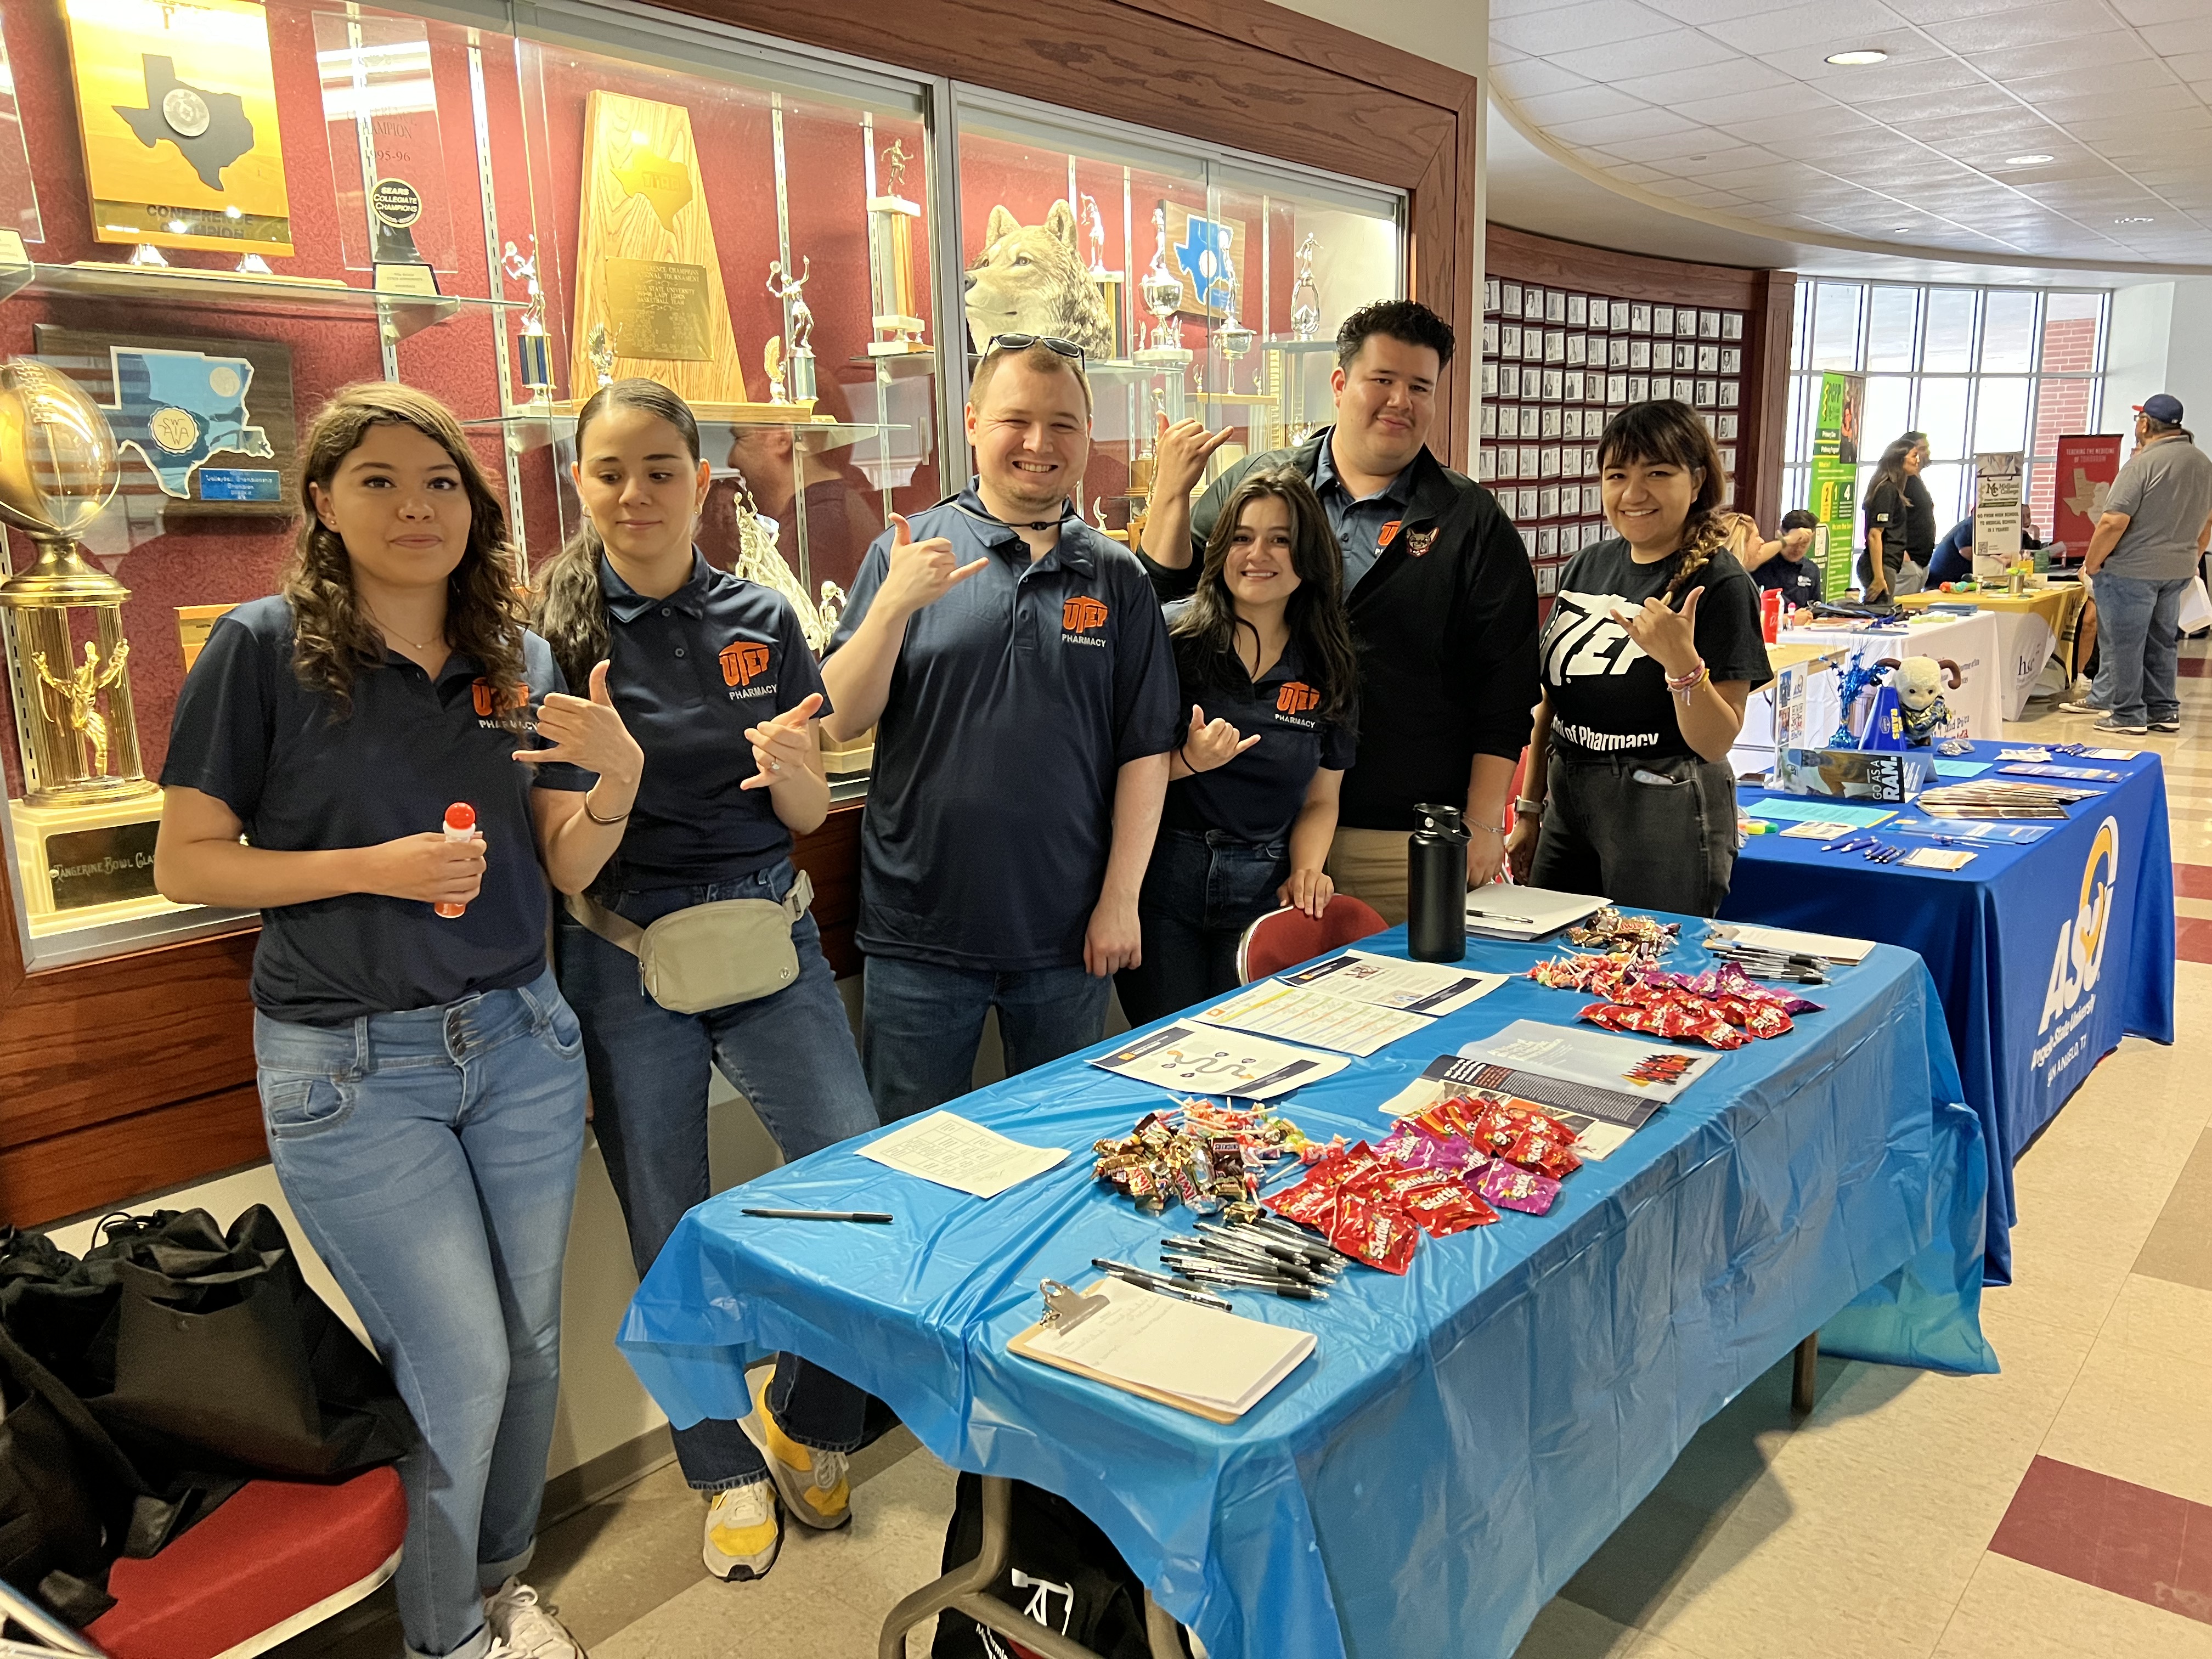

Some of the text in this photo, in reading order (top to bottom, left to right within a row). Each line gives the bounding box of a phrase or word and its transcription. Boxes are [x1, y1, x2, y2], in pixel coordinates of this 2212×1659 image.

[365, 149, 410, 161] 1995-96
[374, 194, 417, 204] COLLEGIATE
[381, 187, 409, 196] SEARS
[376, 202, 417, 212] CHAMPIONS
[664, 273, 699, 282] TOURNAMENT
[667, 286, 695, 295] UNIVERSITY
[1825, 484, 1850, 503] 2 1 4
[1063, 595, 1108, 633] UTEP
[1062, 634, 1107, 647] PHARMACY
[719, 641, 769, 686] UTEP
[729, 684, 777, 700] PHARMACY
[1274, 714, 1316, 729] PHARMACY
[1565, 725, 1578, 744] of
[1578, 725, 1659, 751] Pharmacy
[1871, 769, 1881, 782] AS
[1872, 785, 1882, 800] GO
[53, 851, 154, 883] TANGERINE BOWL CLA
[2038, 878, 2115, 1036] ASU
